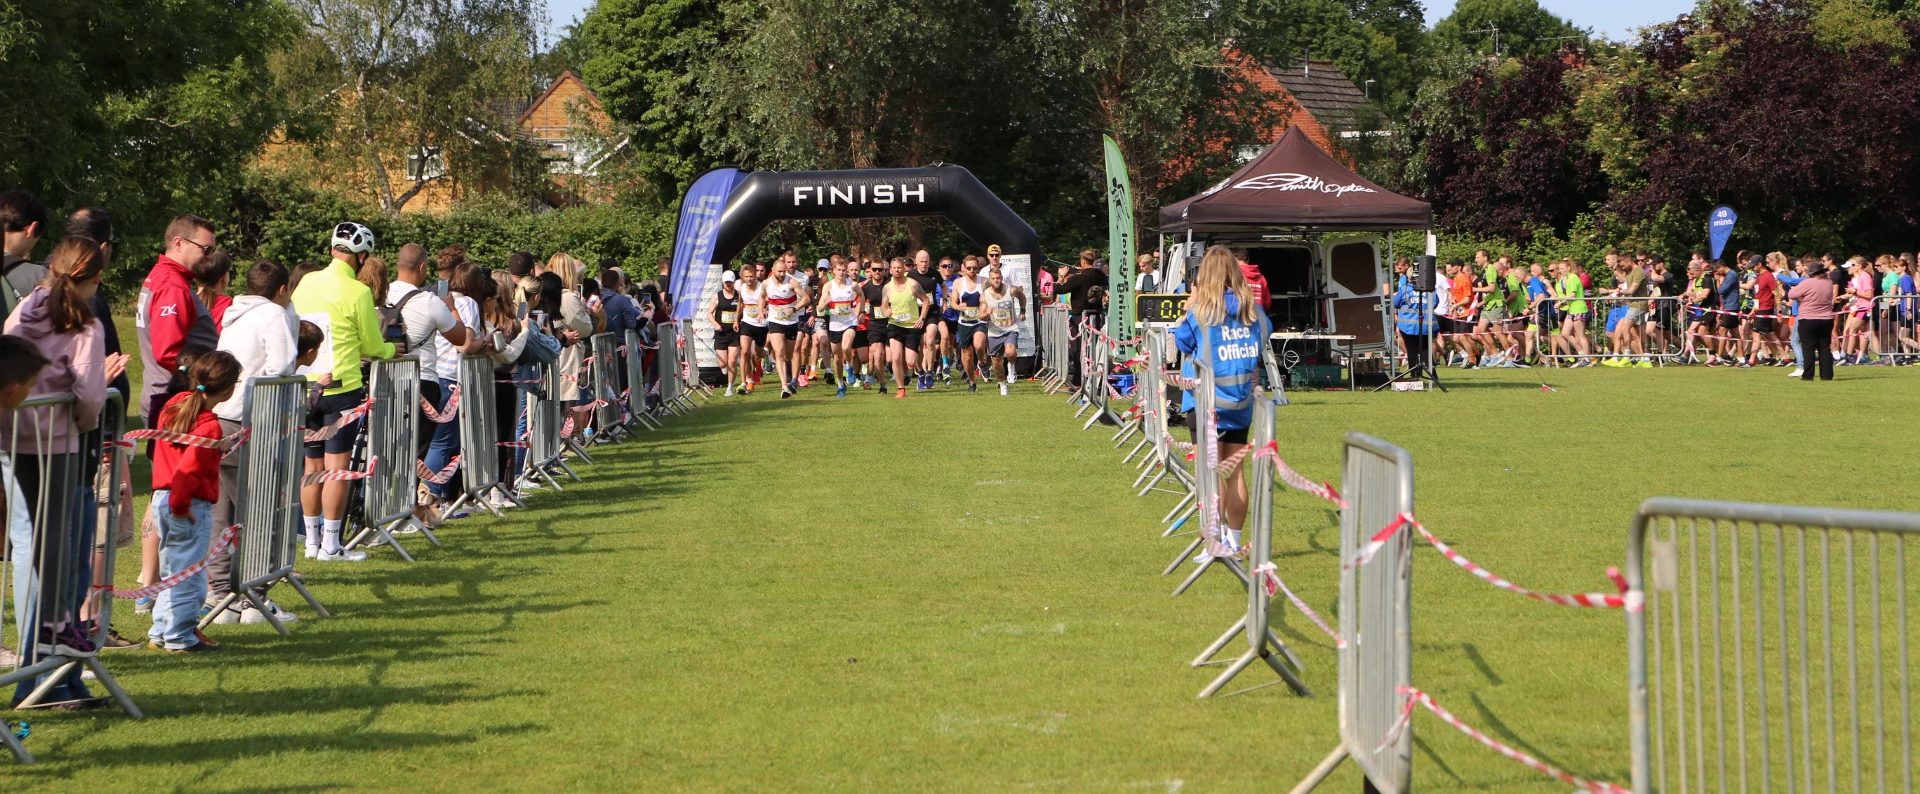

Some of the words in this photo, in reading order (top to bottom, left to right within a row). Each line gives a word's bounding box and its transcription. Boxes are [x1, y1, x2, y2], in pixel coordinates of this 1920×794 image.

[793, 183, 925, 206] FINISH
[677, 195, 721, 303] Finish
[1221, 325, 1251, 341] Race
[1218, 342, 1259, 361] Official
